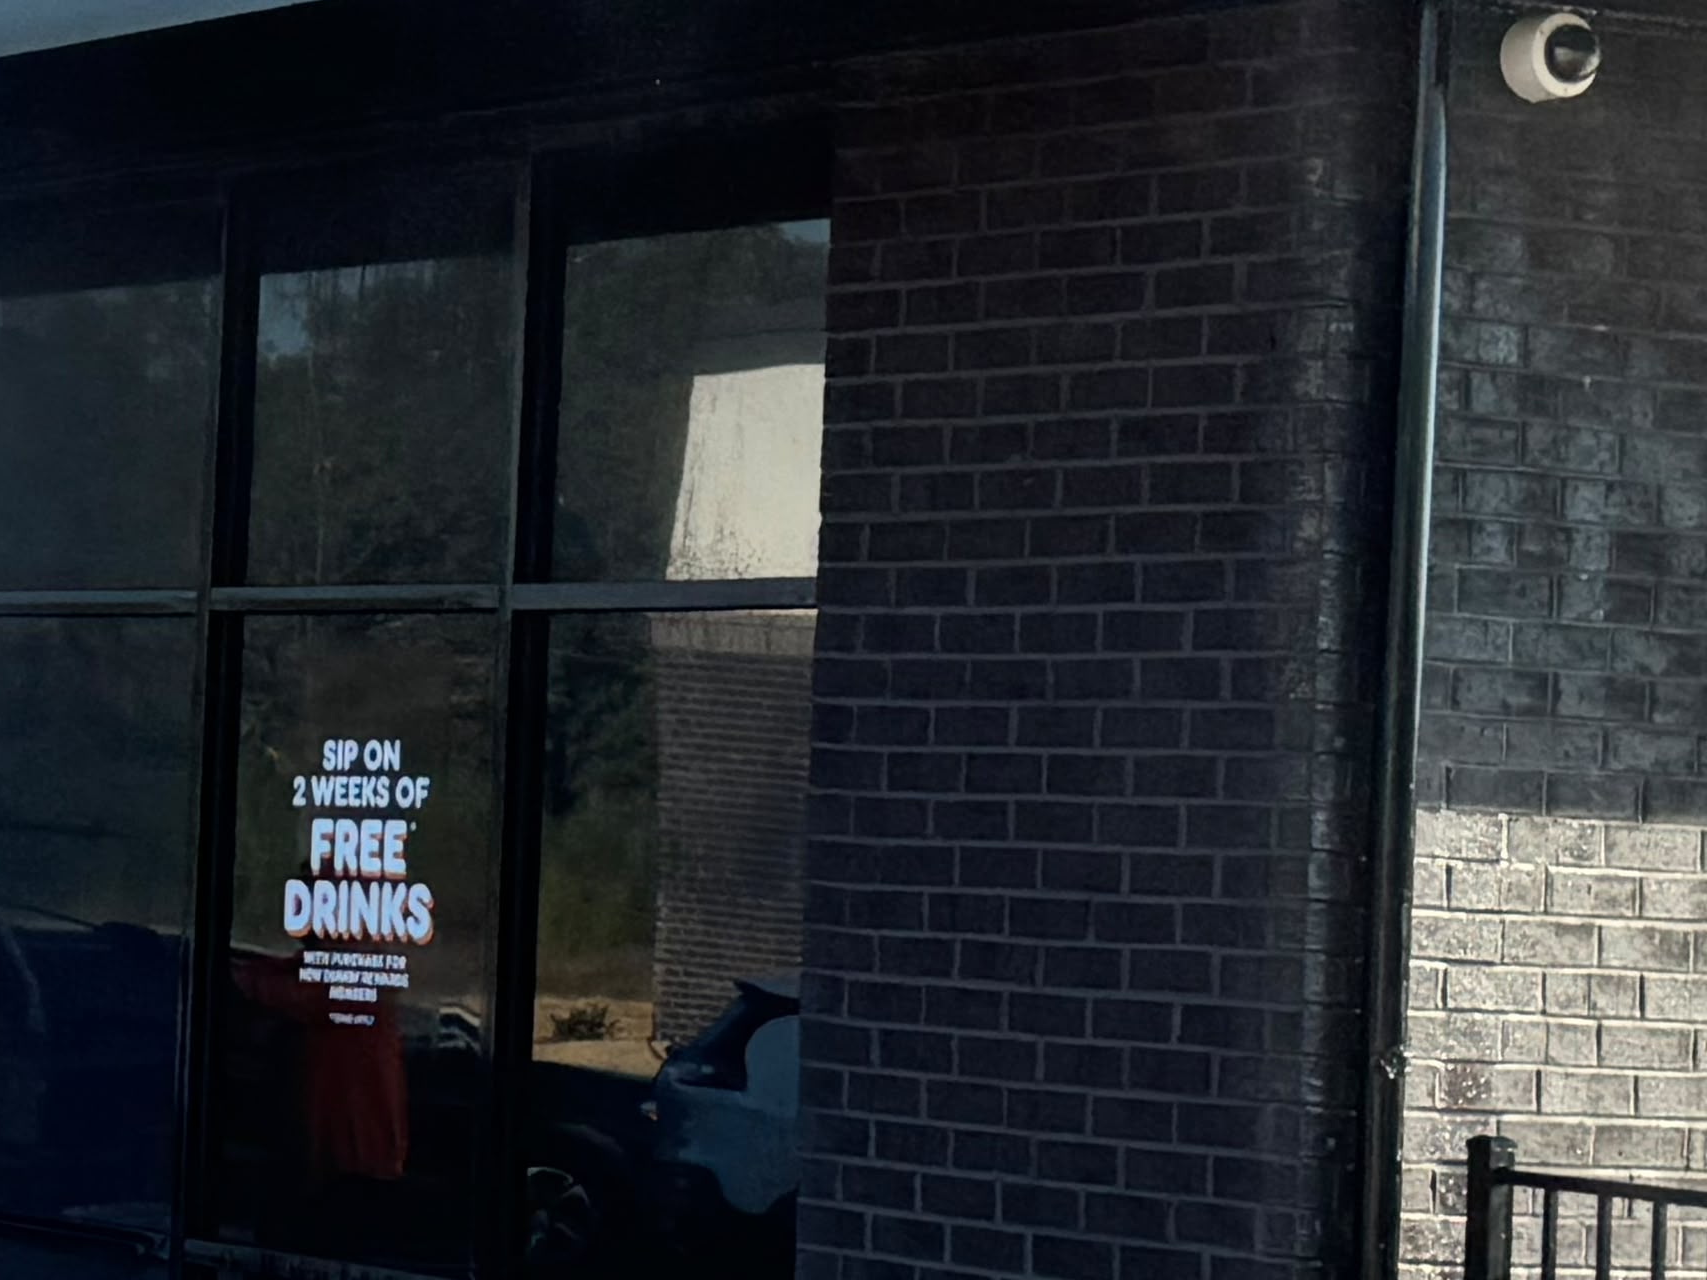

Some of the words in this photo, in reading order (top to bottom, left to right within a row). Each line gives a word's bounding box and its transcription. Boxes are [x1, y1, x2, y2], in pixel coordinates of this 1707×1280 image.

[322, 739, 359, 771] SIP
[363, 739, 401, 771] ON
[292, 775, 307, 806] 2
[310, 775, 390, 808] WEEKS
[395, 776, 431, 809] OF
[284, 879, 434, 945] DRINKS
